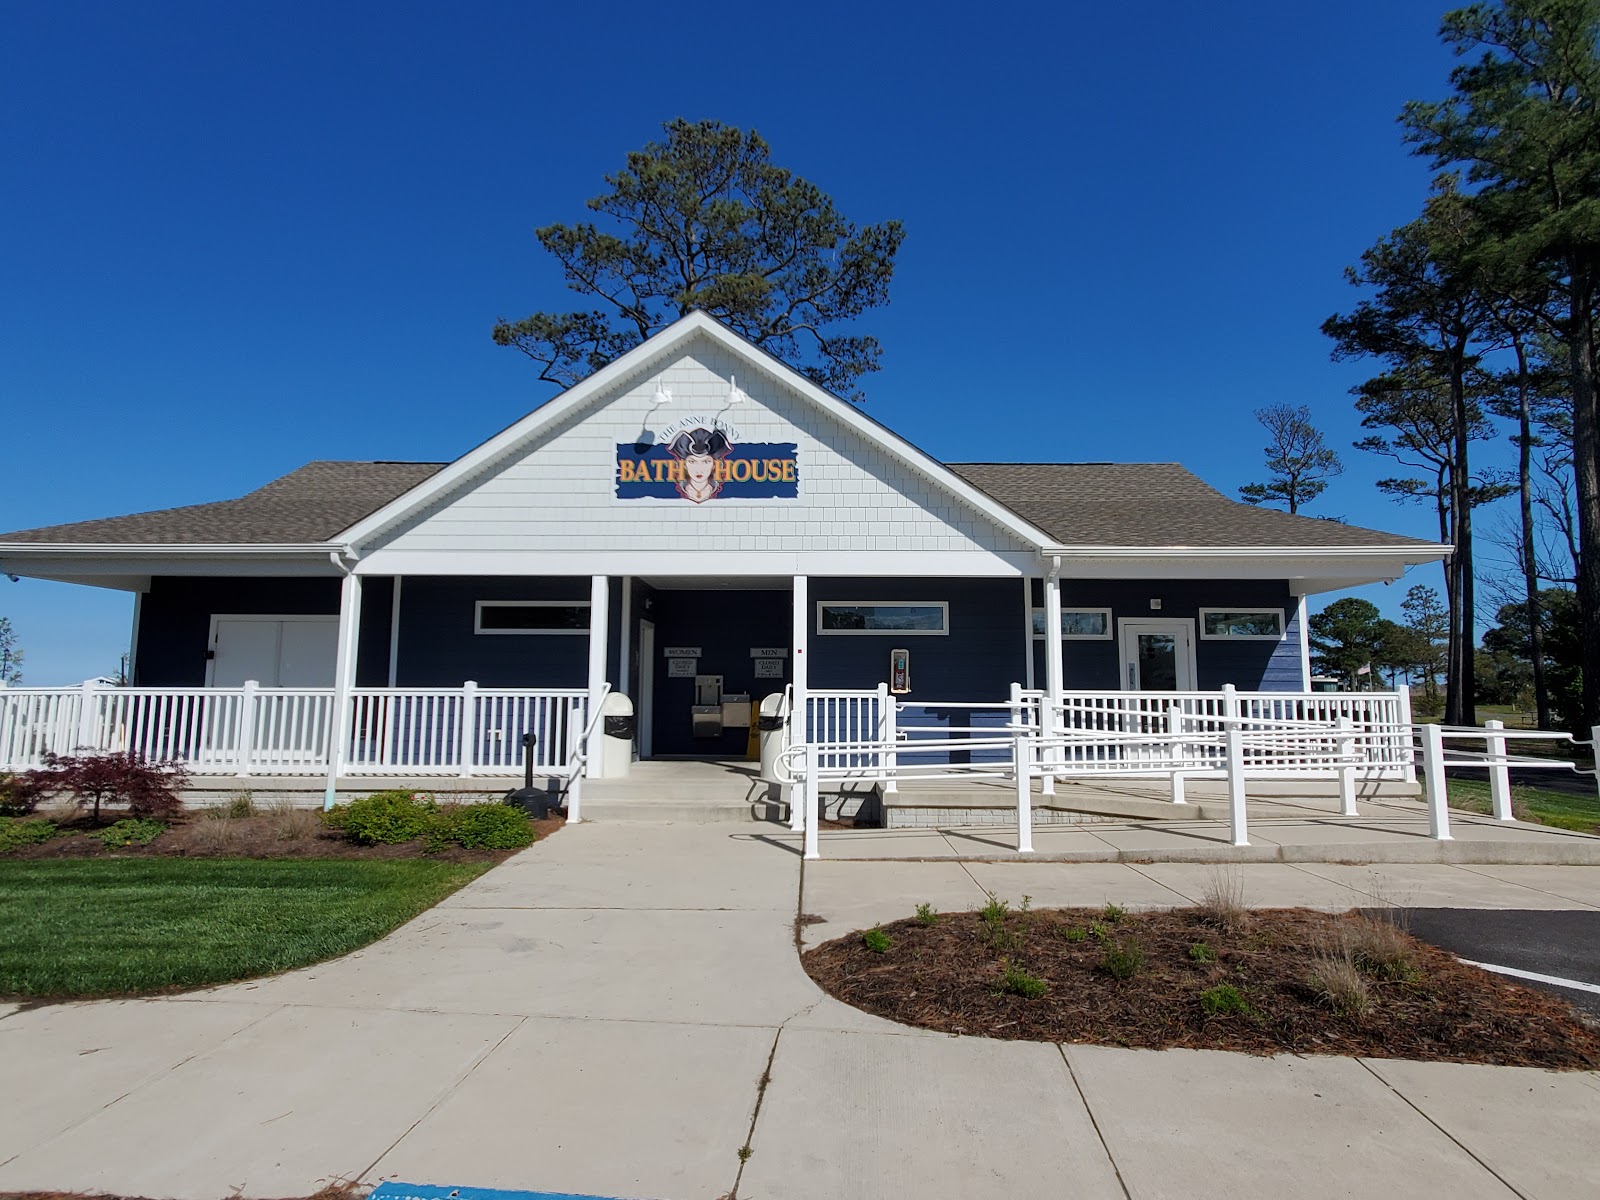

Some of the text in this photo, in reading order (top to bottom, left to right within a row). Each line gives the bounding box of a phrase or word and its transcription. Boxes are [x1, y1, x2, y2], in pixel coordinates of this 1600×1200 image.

[659, 424, 676, 441] THE
[679, 416, 707, 428] ANNE
[619, 459, 796, 482] BATH HOUSE
